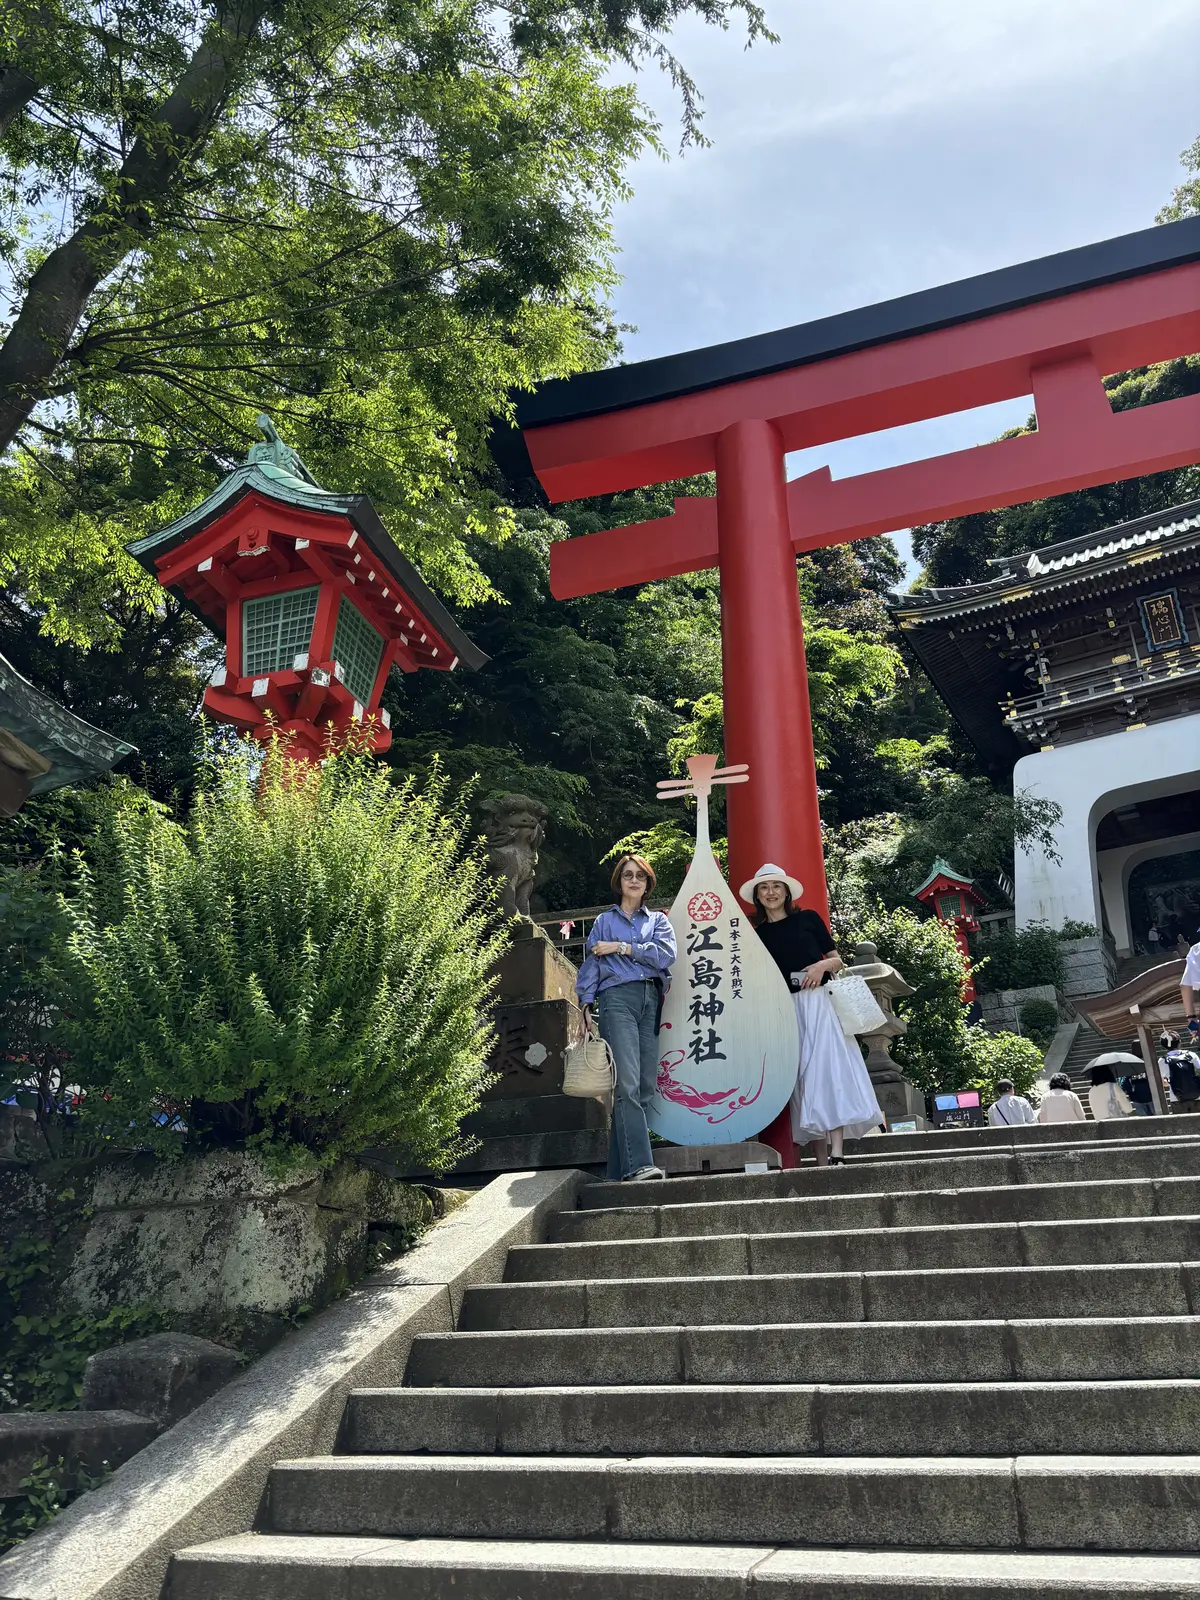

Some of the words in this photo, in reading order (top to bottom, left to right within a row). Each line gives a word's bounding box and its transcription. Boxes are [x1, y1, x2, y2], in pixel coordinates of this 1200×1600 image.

[686, 923, 727, 1065] 江島神社
[729, 917, 743, 999] 日本三大弁財天
